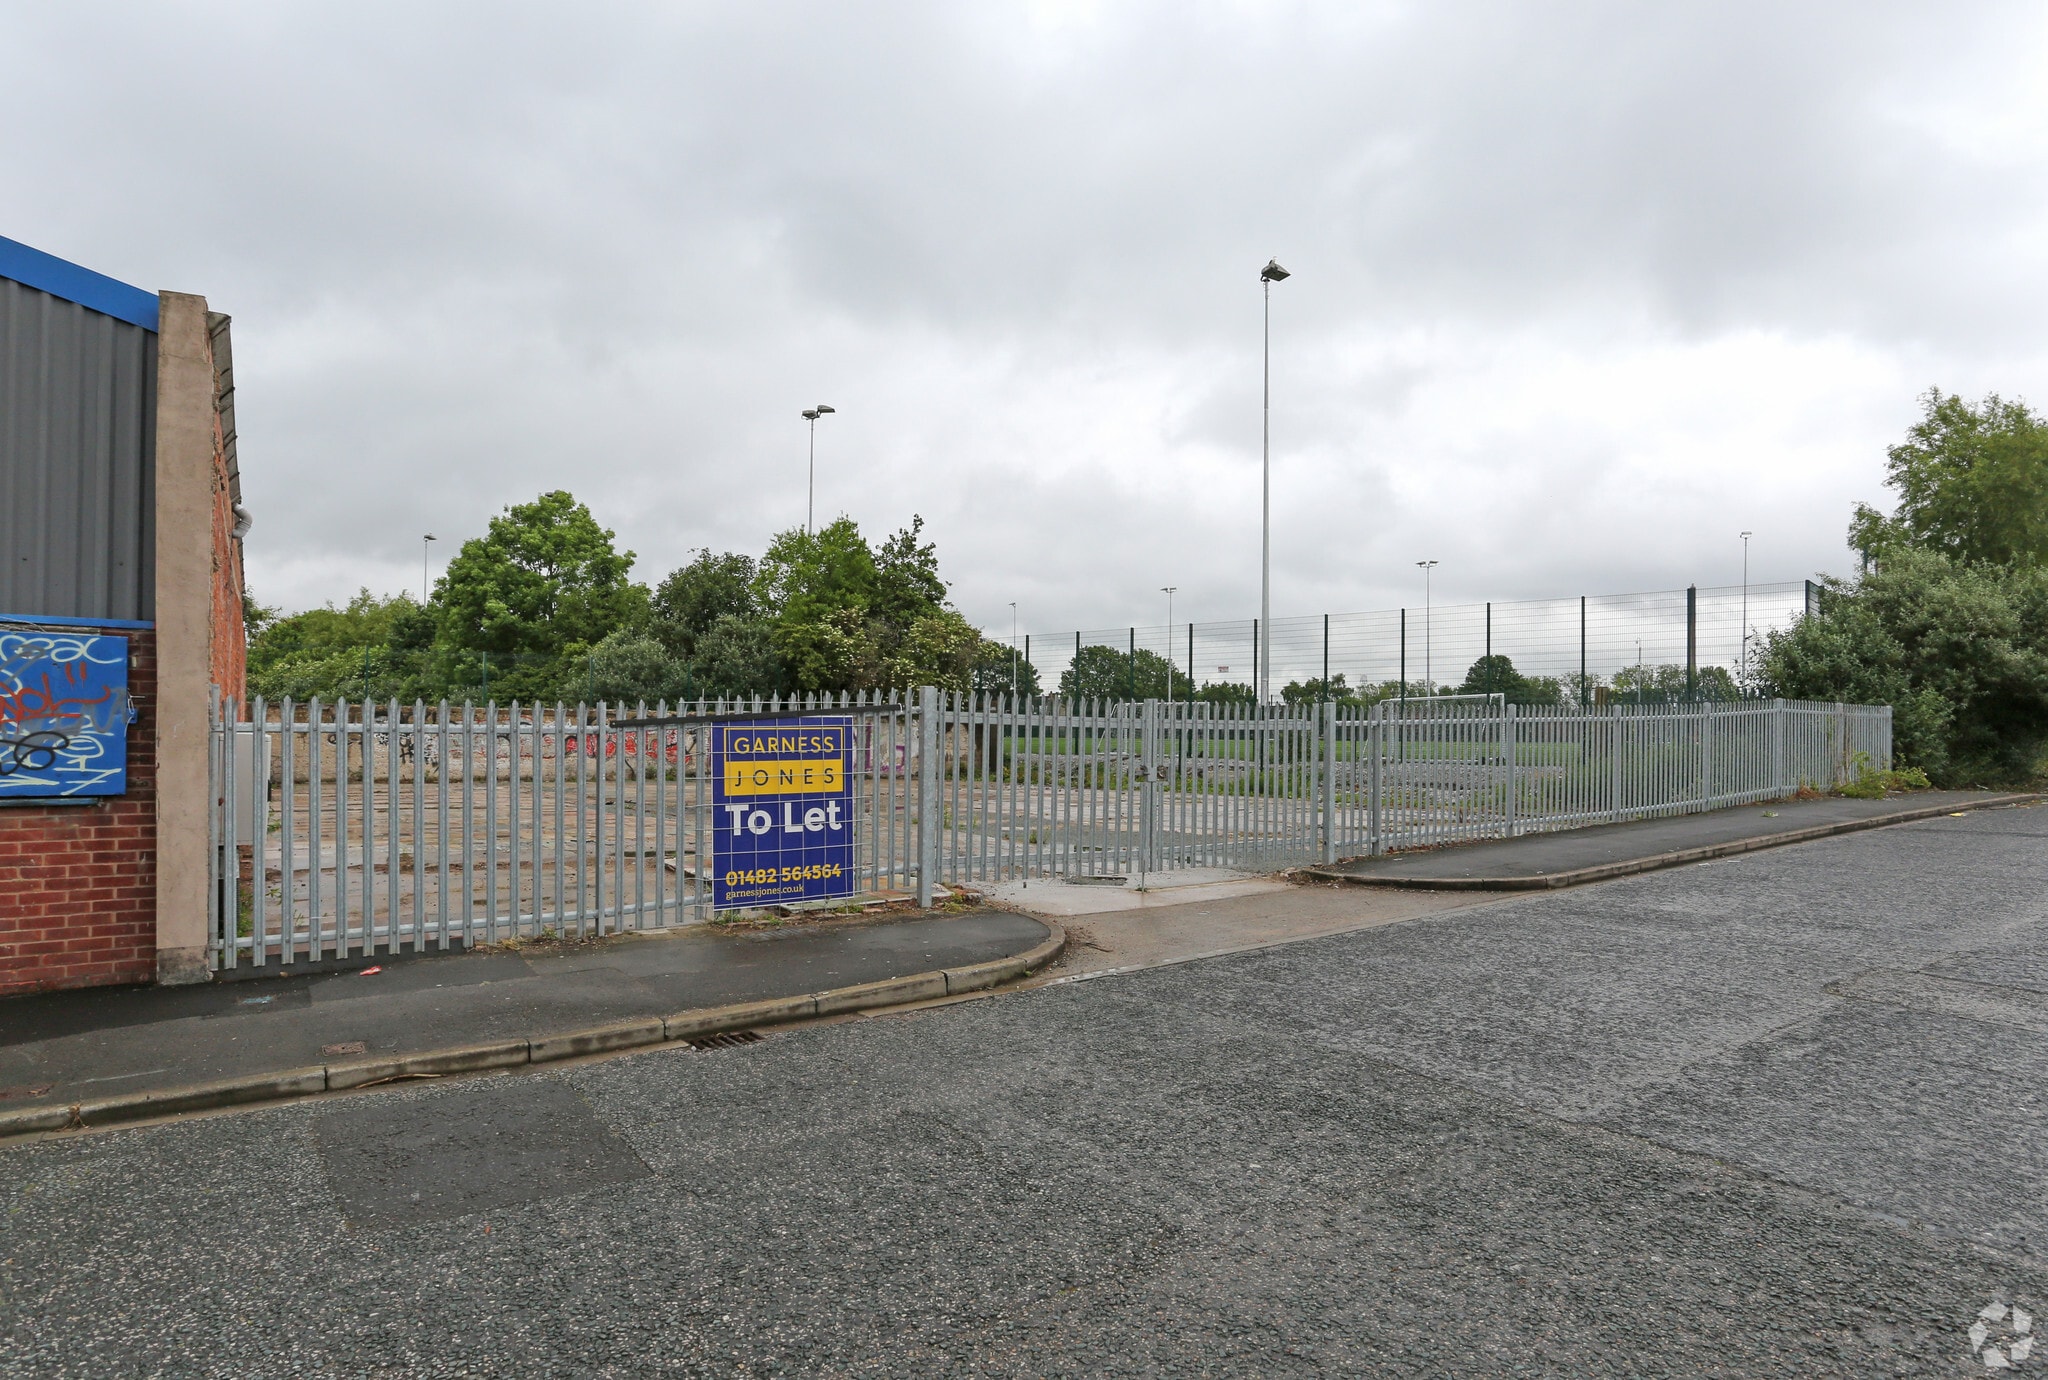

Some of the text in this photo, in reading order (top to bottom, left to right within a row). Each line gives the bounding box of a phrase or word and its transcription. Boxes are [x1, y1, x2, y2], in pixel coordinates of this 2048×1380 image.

[734, 736, 834, 754] GARNESS
[735, 768, 834, 787] JONES
[725, 800, 842, 836] To Let
[725, 863, 842, 887] 01482 564564
[725, 884, 804, 900] garnessjones.co.uk
